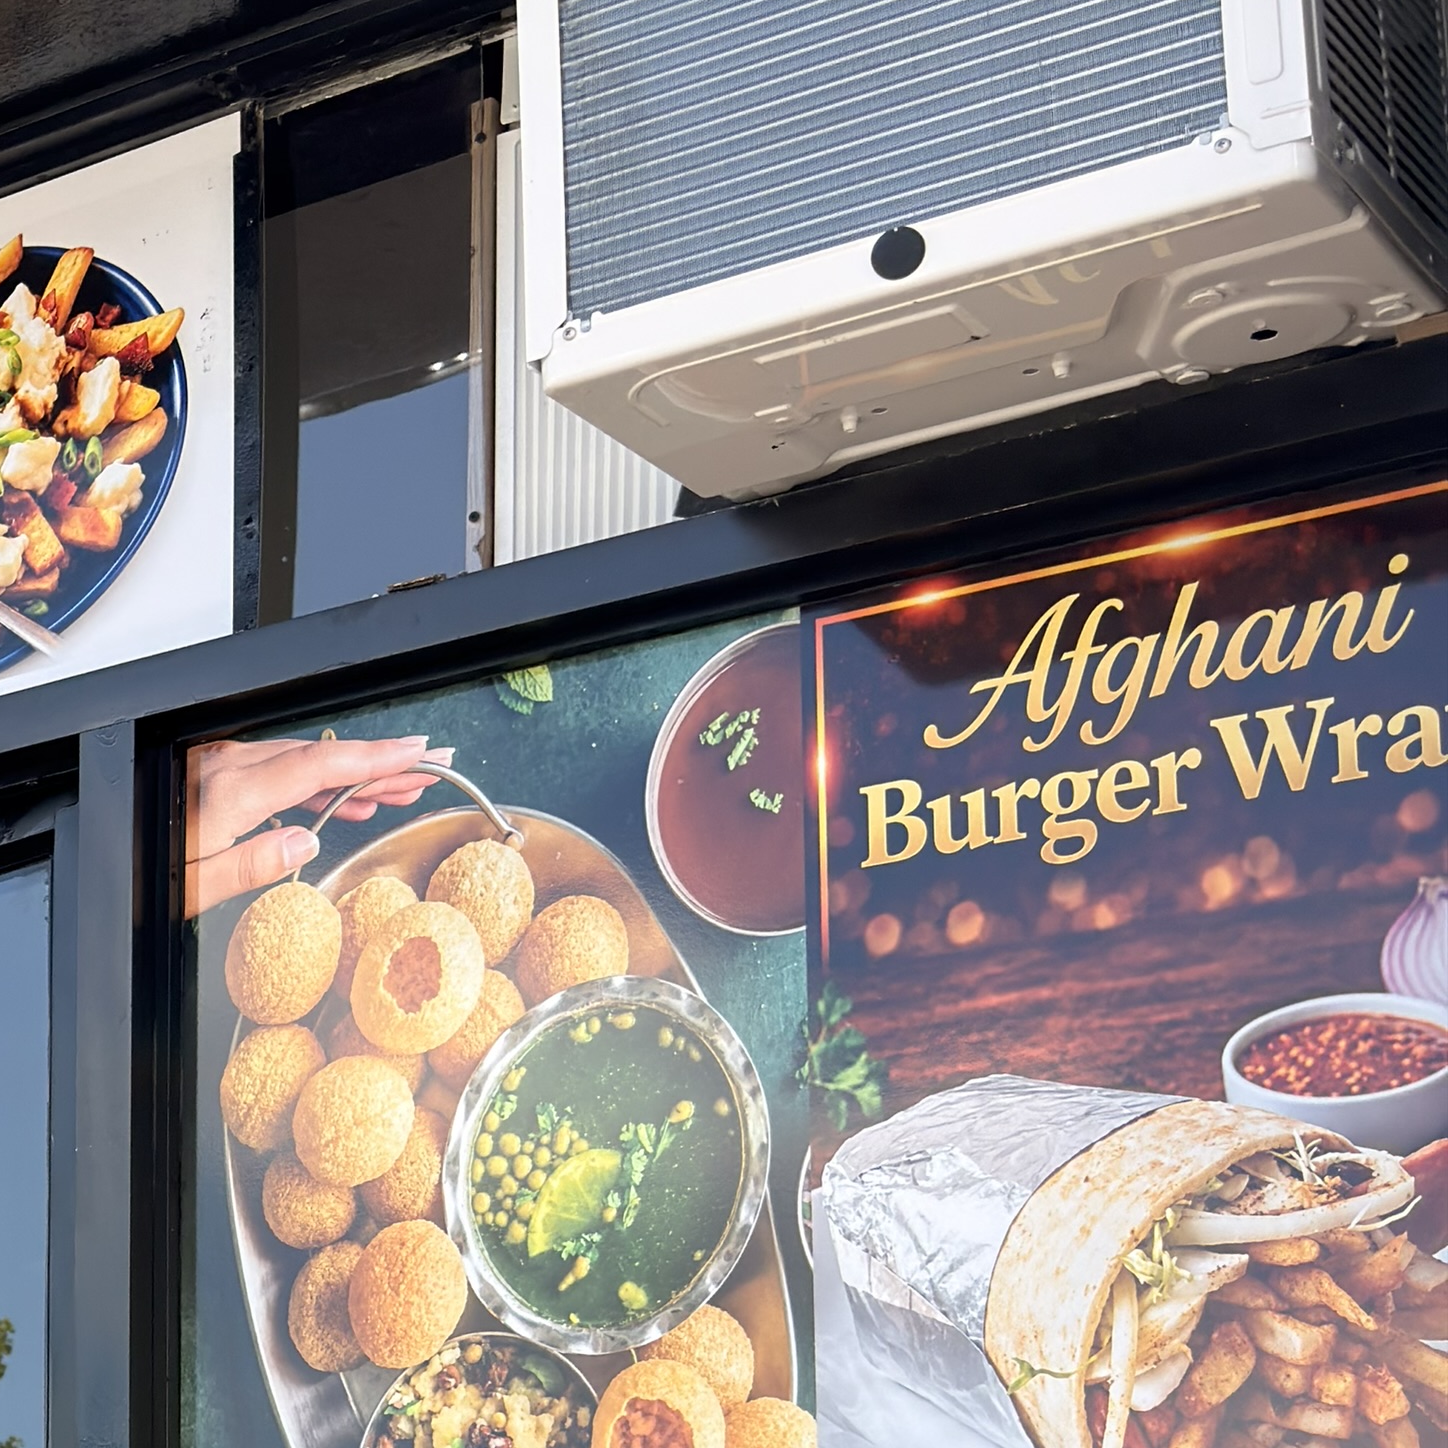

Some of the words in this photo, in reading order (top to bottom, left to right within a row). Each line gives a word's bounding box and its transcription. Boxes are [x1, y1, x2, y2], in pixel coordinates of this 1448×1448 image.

[924, 554, 1415, 752] Afghani
[860, 748, 1202, 868] Burger
[1210, 696, 1448, 801] Wra
